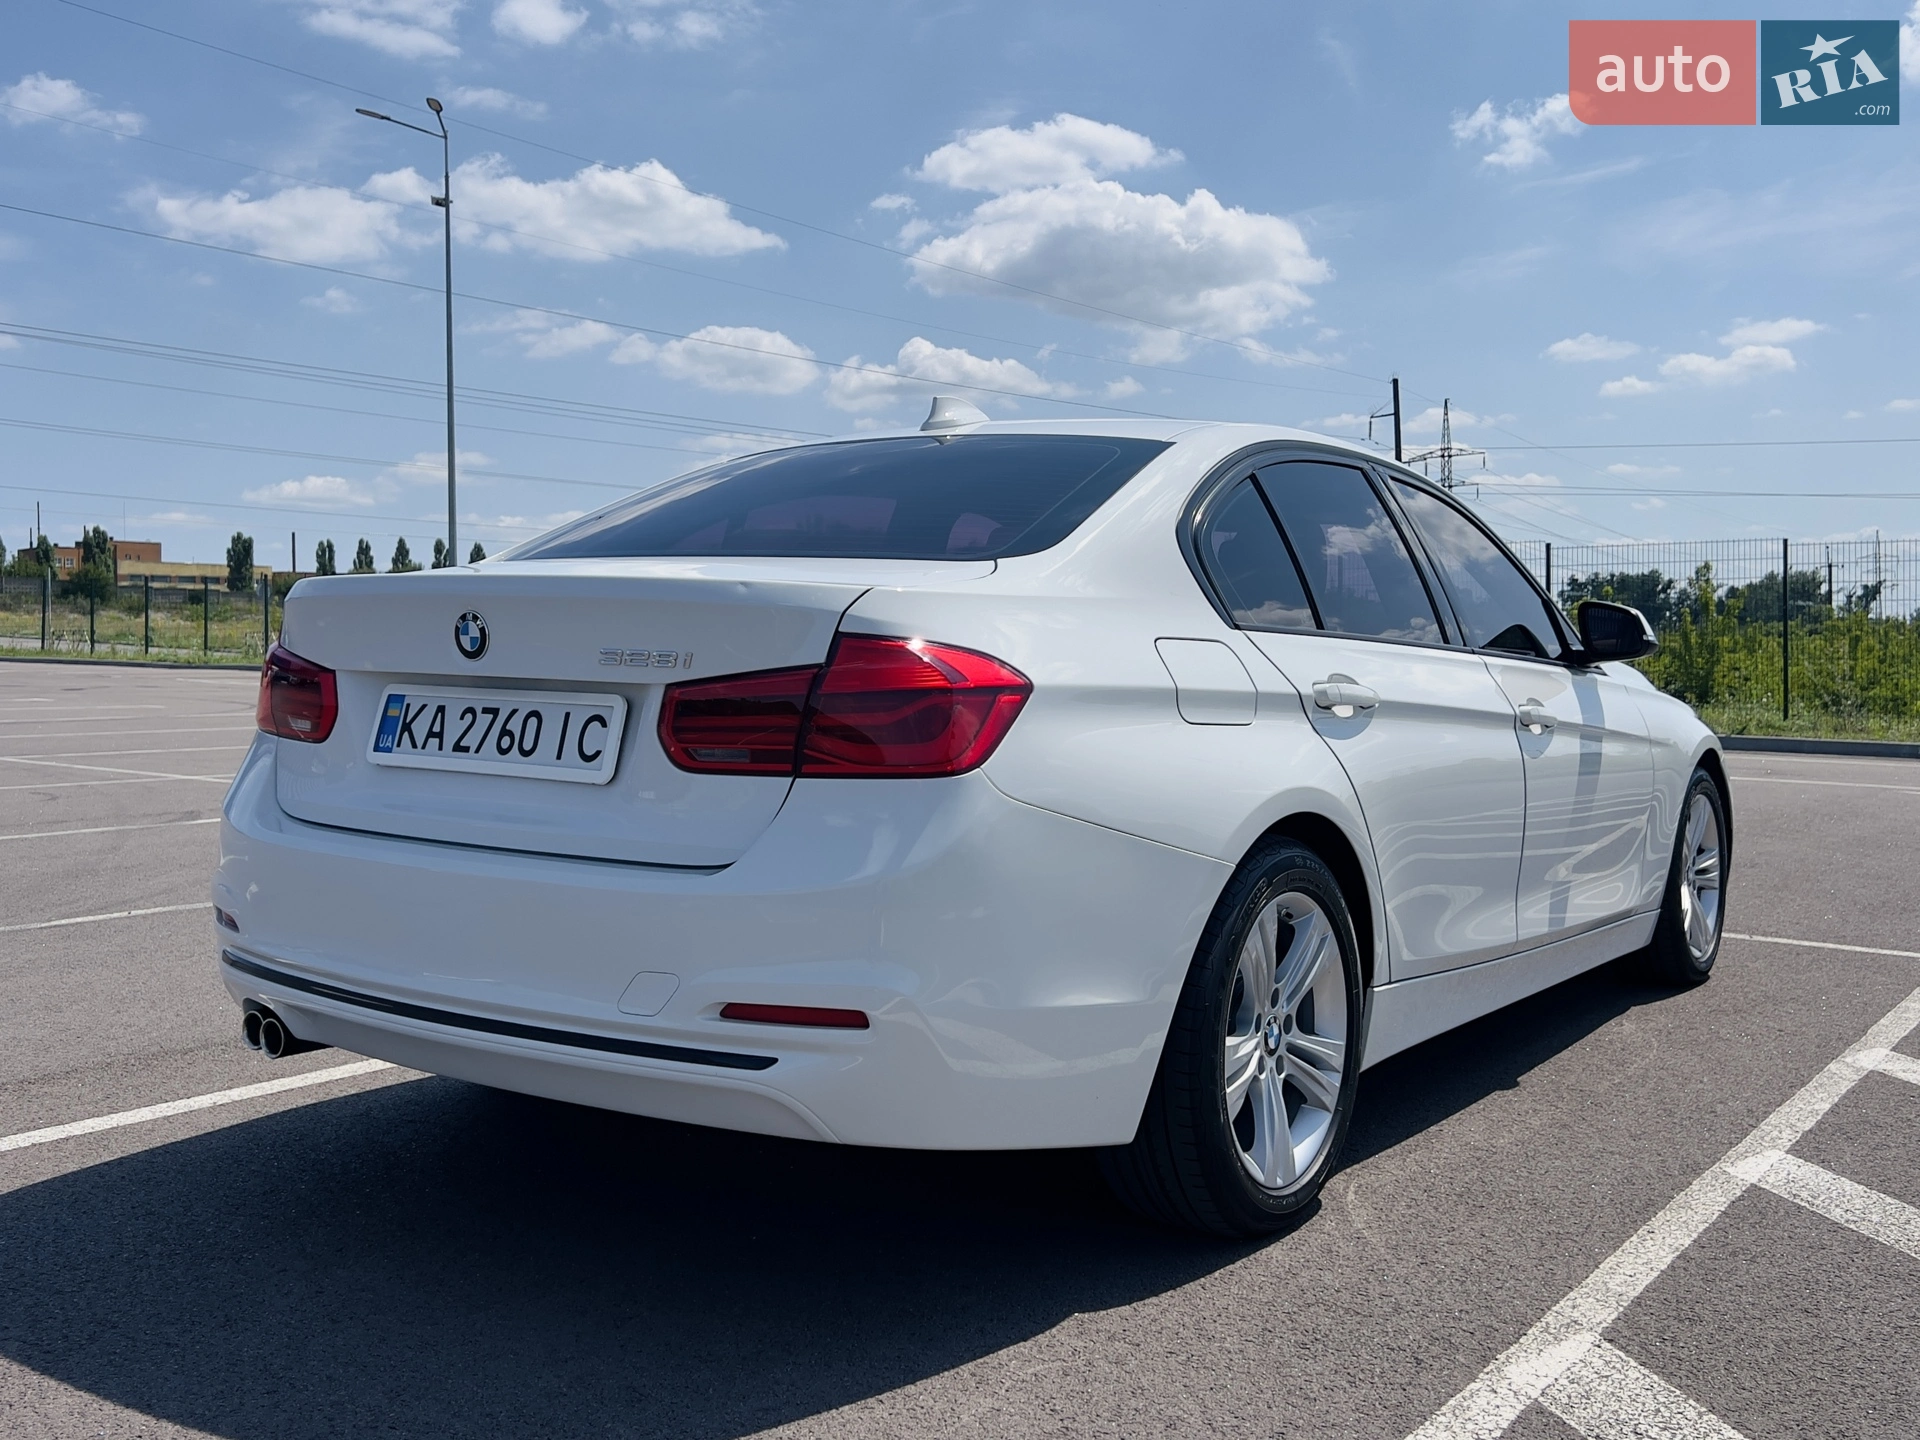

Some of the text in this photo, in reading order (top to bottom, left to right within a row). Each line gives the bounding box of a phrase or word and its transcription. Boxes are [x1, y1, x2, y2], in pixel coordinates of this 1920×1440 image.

[599, 648, 693, 669] 328i
[379, 734, 393, 748] UA
[396, 702, 608, 763] KA 2760 IC
